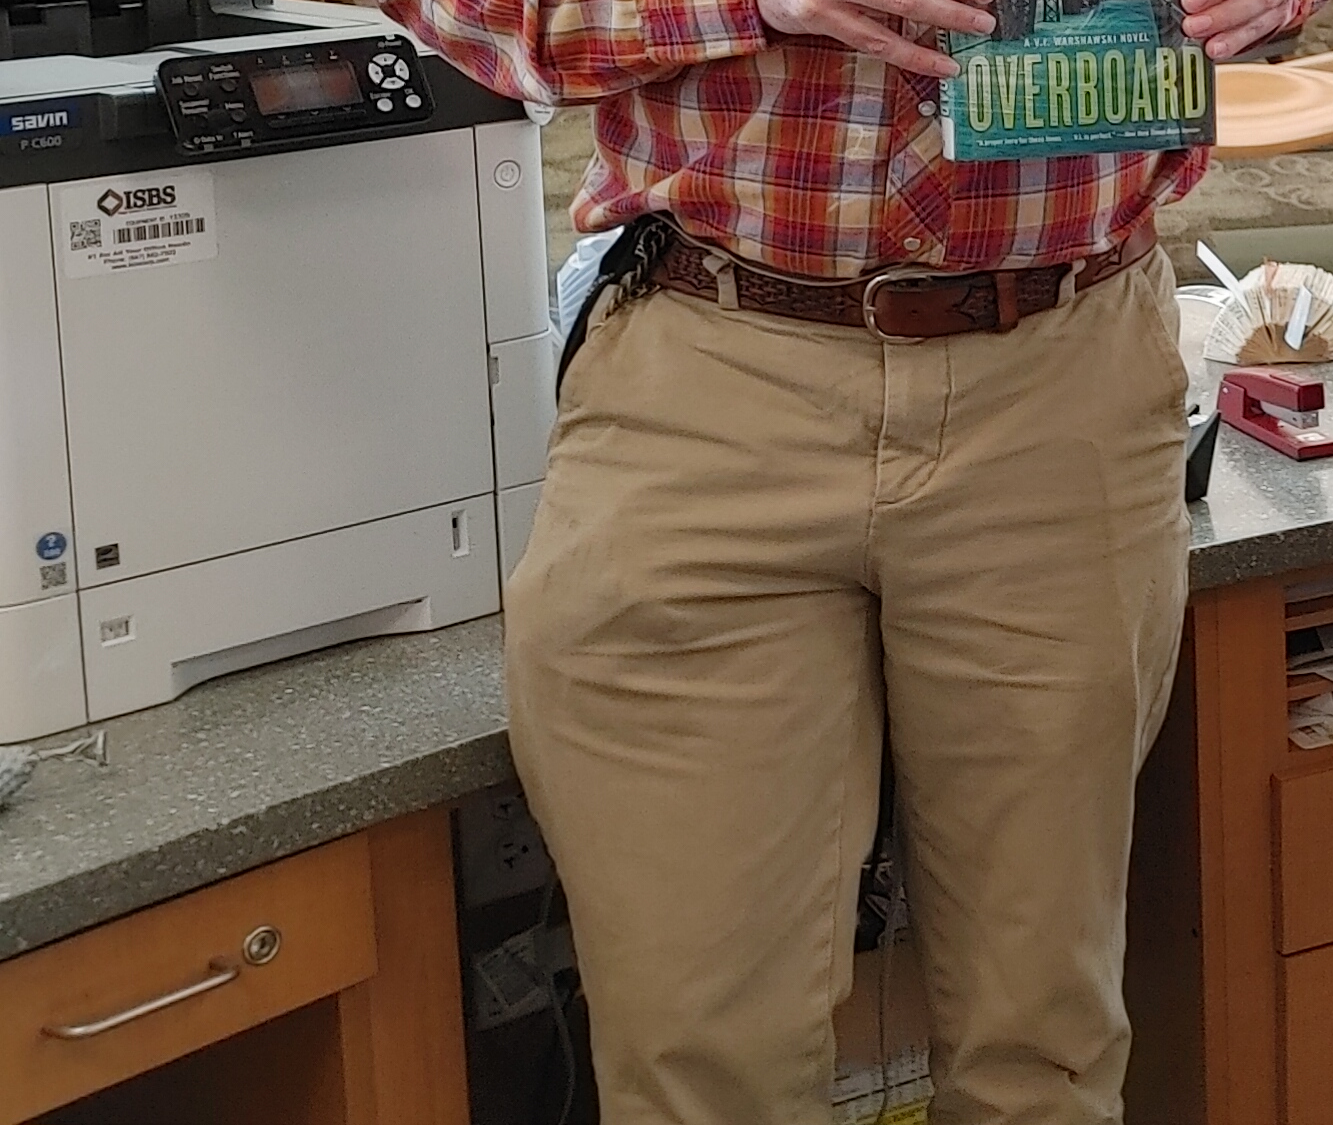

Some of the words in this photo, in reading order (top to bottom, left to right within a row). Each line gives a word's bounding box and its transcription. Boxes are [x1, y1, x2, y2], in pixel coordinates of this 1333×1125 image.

[1024, 38, 1030, 48] A
[1054, 36, 1117, 46] WARSHAWSKI
[1120, 35, 1149, 44] NOVEL
[967, 45, 1207, 132] OVERBOARD
[11, 111, 68, 131] savin
[123, 185, 176, 209] ISBS
